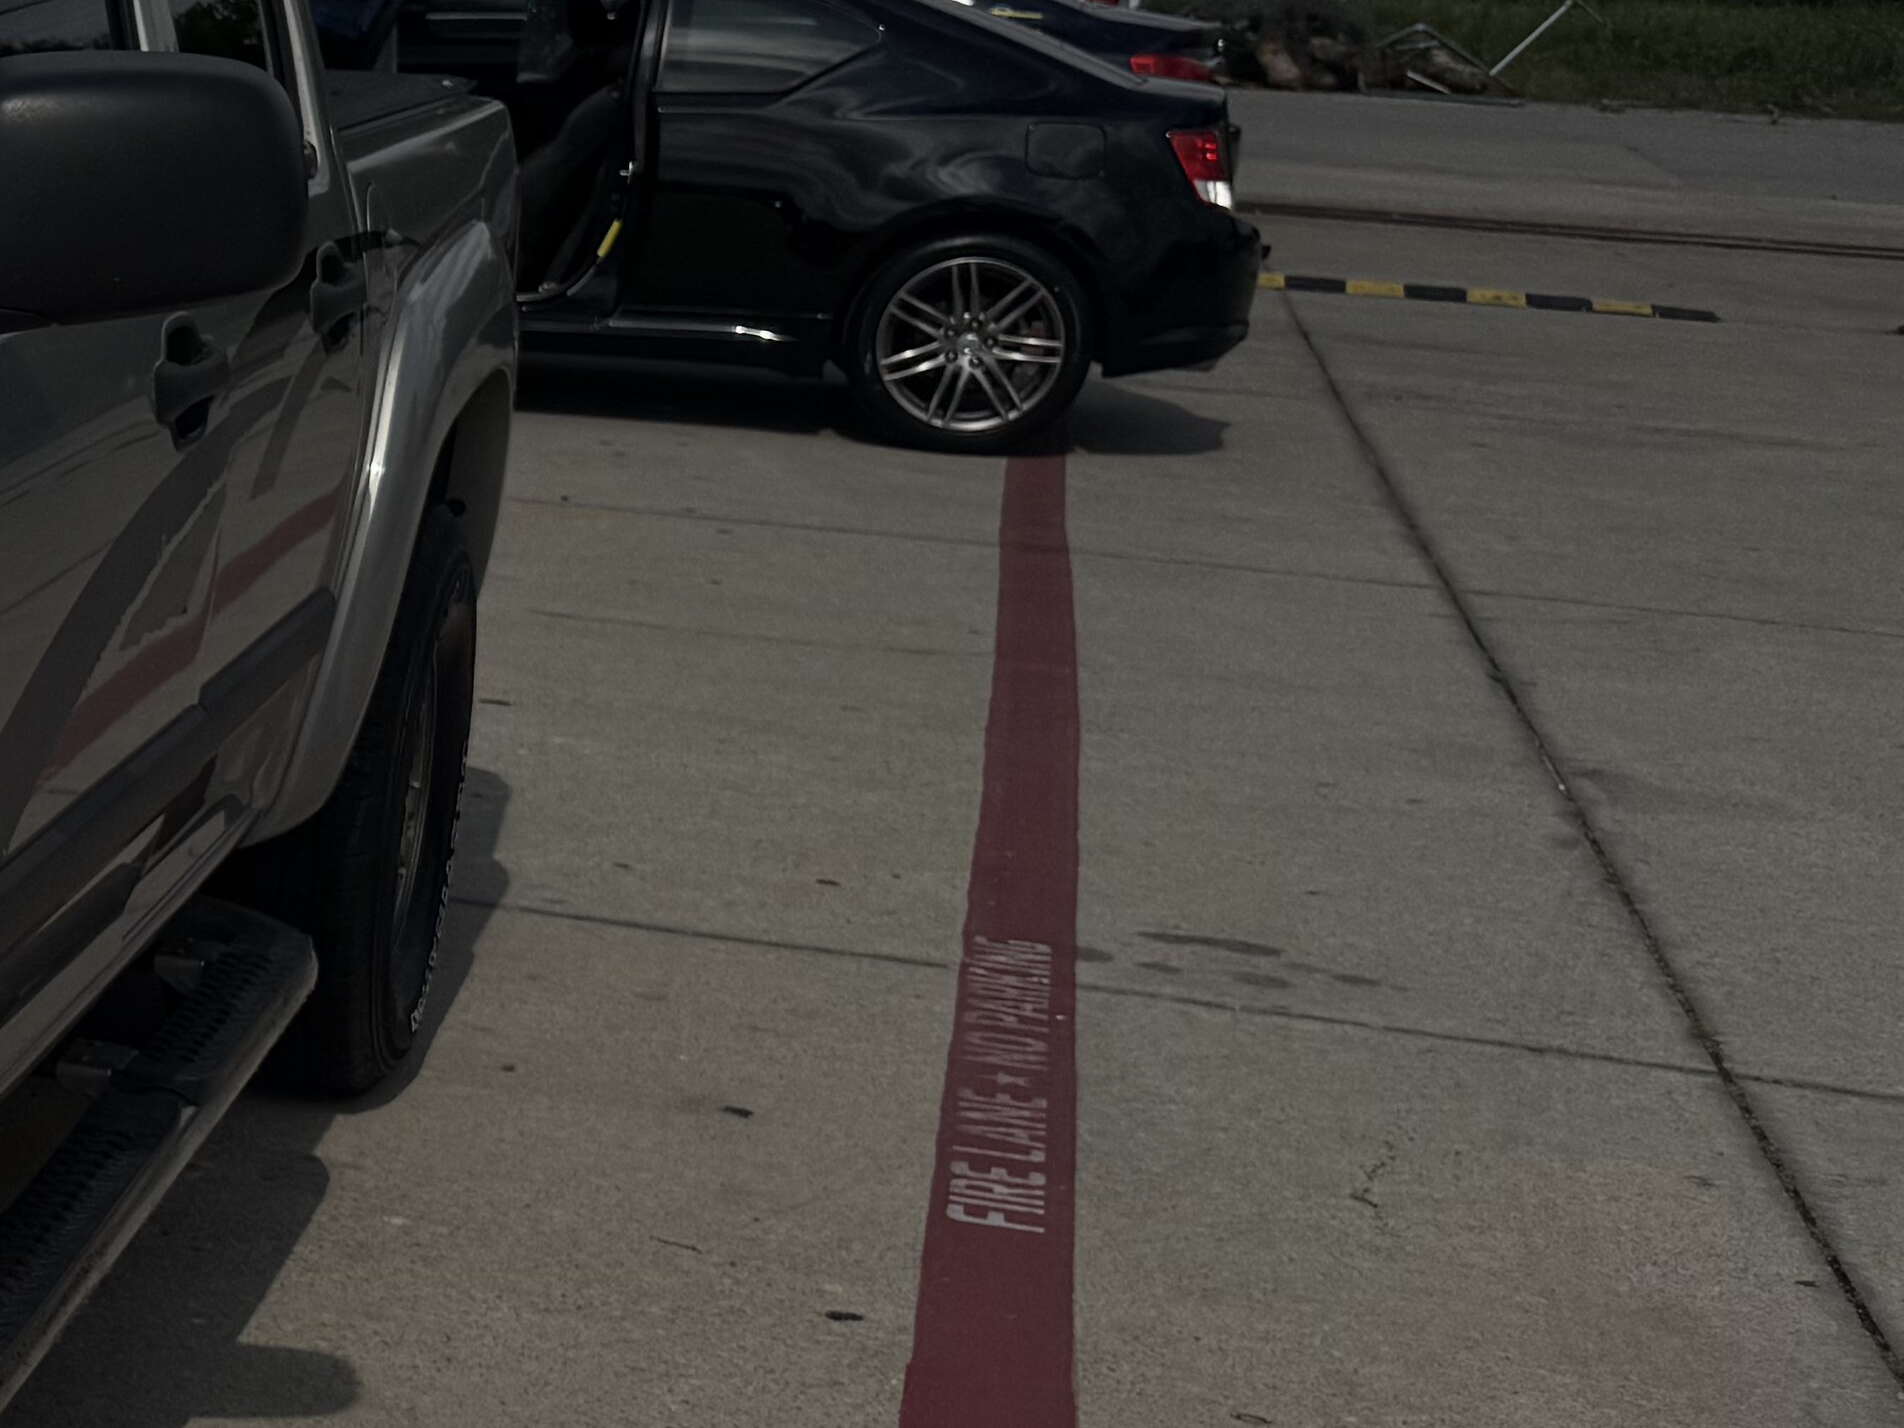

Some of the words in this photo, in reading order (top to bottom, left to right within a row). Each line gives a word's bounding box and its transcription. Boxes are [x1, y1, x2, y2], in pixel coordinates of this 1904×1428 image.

[962, 934, 1053, 1033] PARKING
[959, 1030, 1049, 1072] NO
[952, 1086, 1047, 1163] LANE
[945, 1160, 1046, 1234] FIRE
